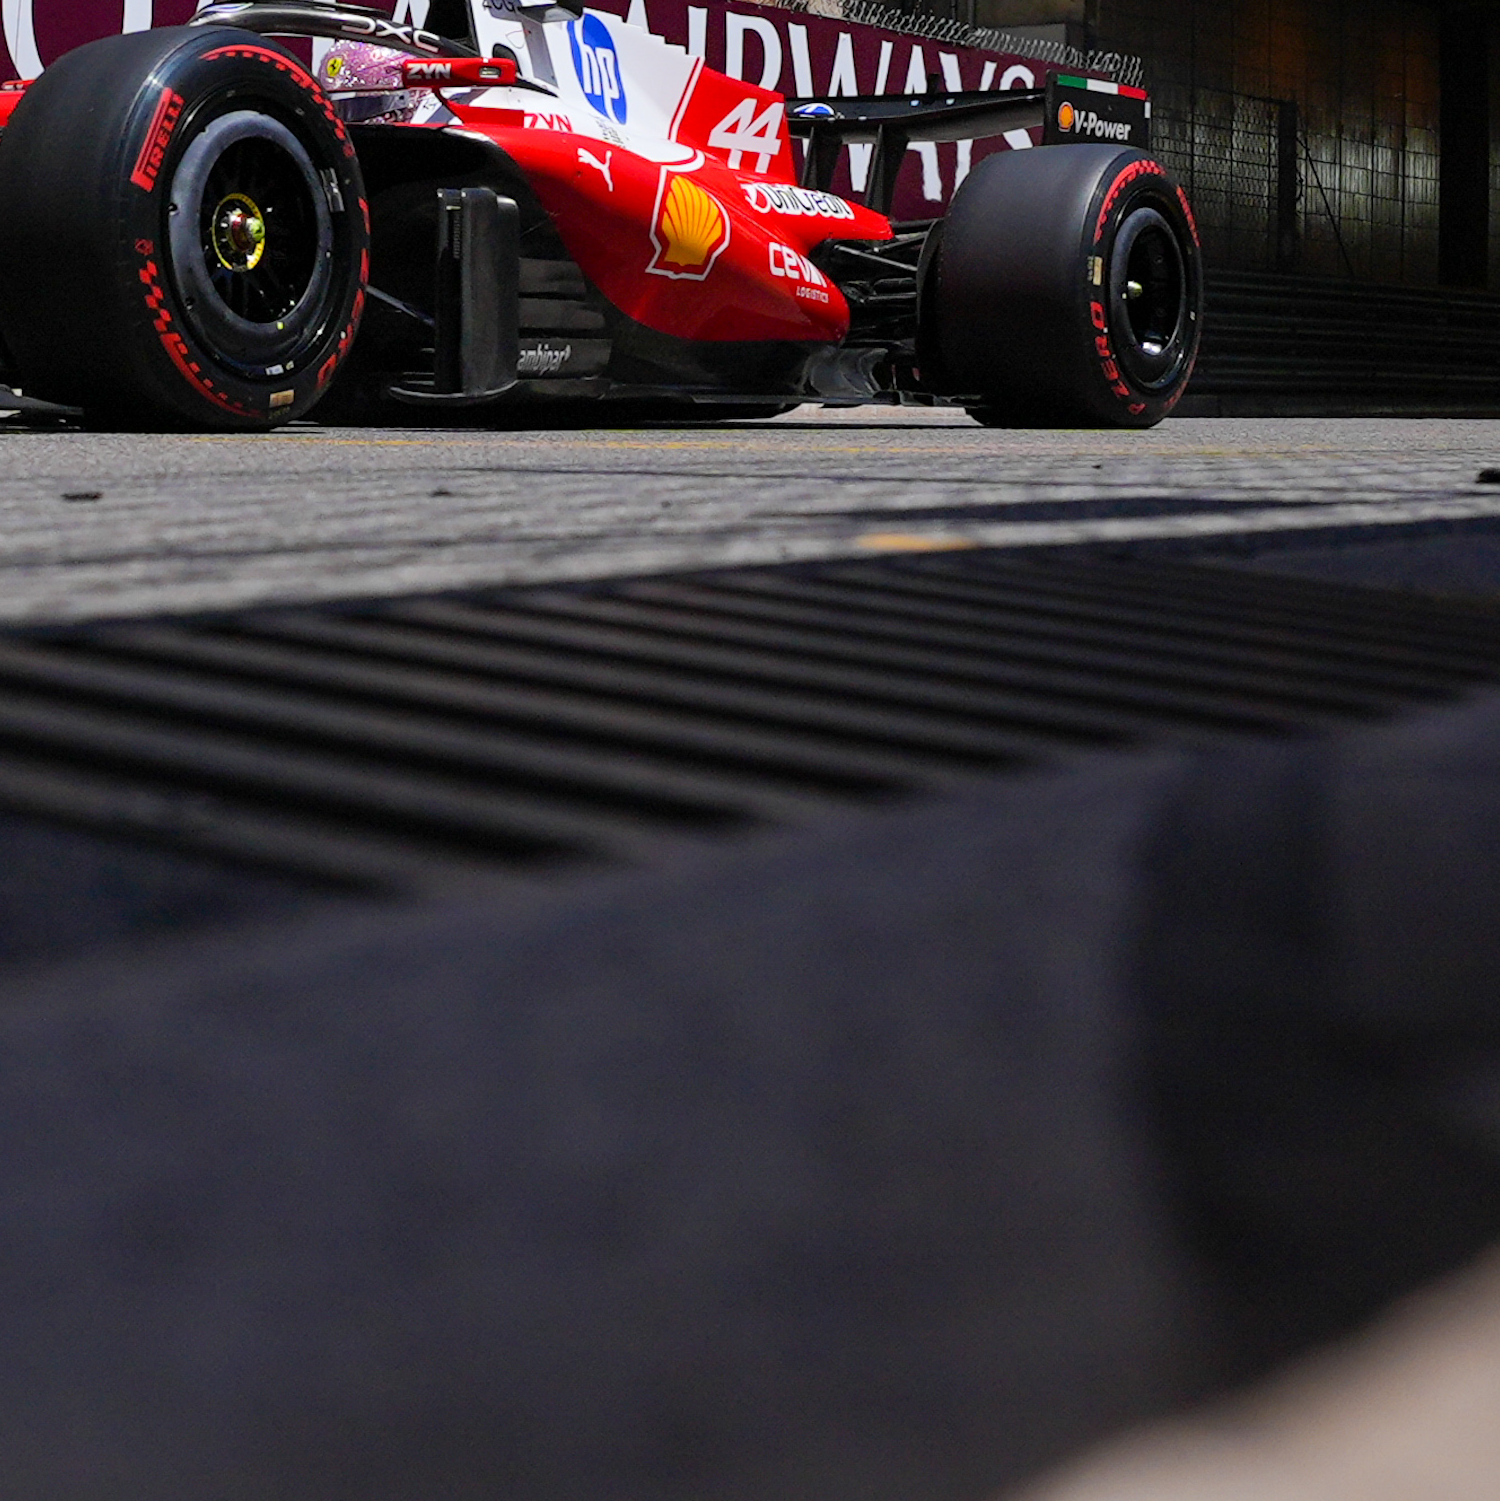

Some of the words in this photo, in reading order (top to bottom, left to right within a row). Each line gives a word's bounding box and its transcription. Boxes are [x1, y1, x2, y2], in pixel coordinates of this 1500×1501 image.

[341, 13, 441, 54] DXC
[405, 62, 453, 80] ZYN
[572, 16, 622, 124] hp
[130, 86, 186, 193] PIRELLI
[707, 97, 786, 174] 44
[1073, 108, 1132, 141] V-Power
